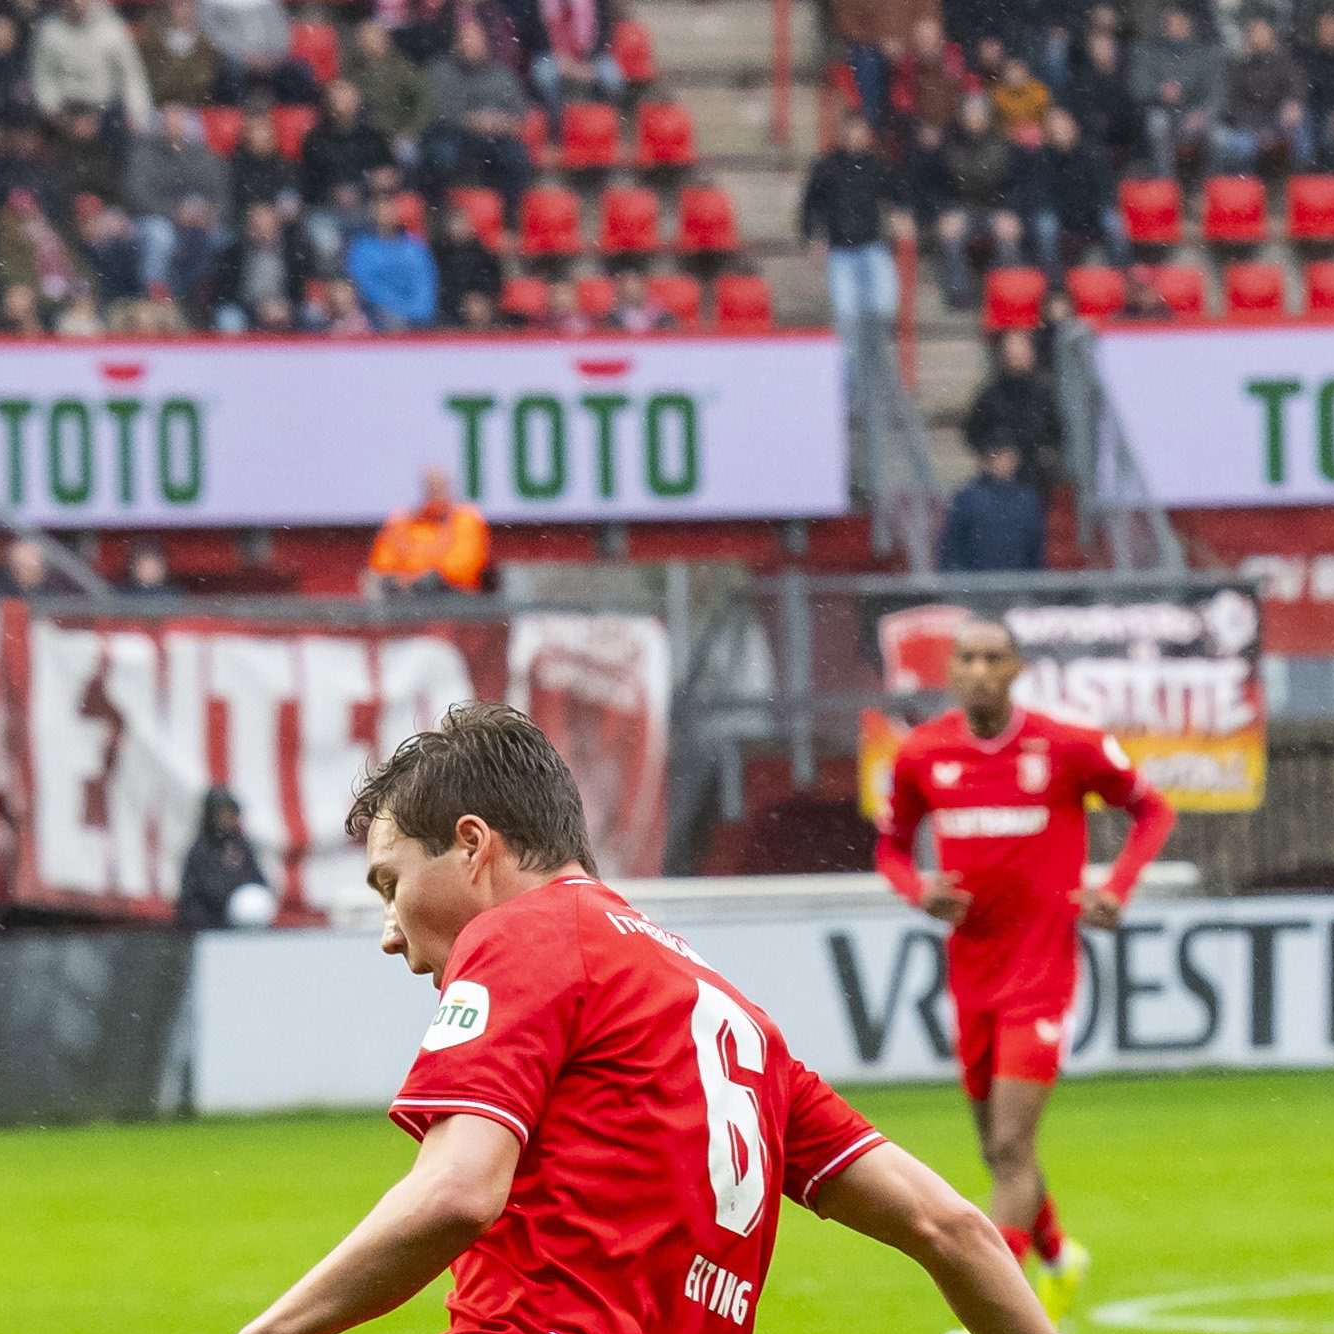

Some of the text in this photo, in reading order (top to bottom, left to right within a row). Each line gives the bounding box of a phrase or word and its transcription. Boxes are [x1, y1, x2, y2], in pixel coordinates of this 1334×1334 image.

[447, 393, 699, 501] TOTO
[432, 1005, 479, 1029] OTO
[691, 978, 766, 1238] 6
[684, 1253, 753, 1326] EITING
